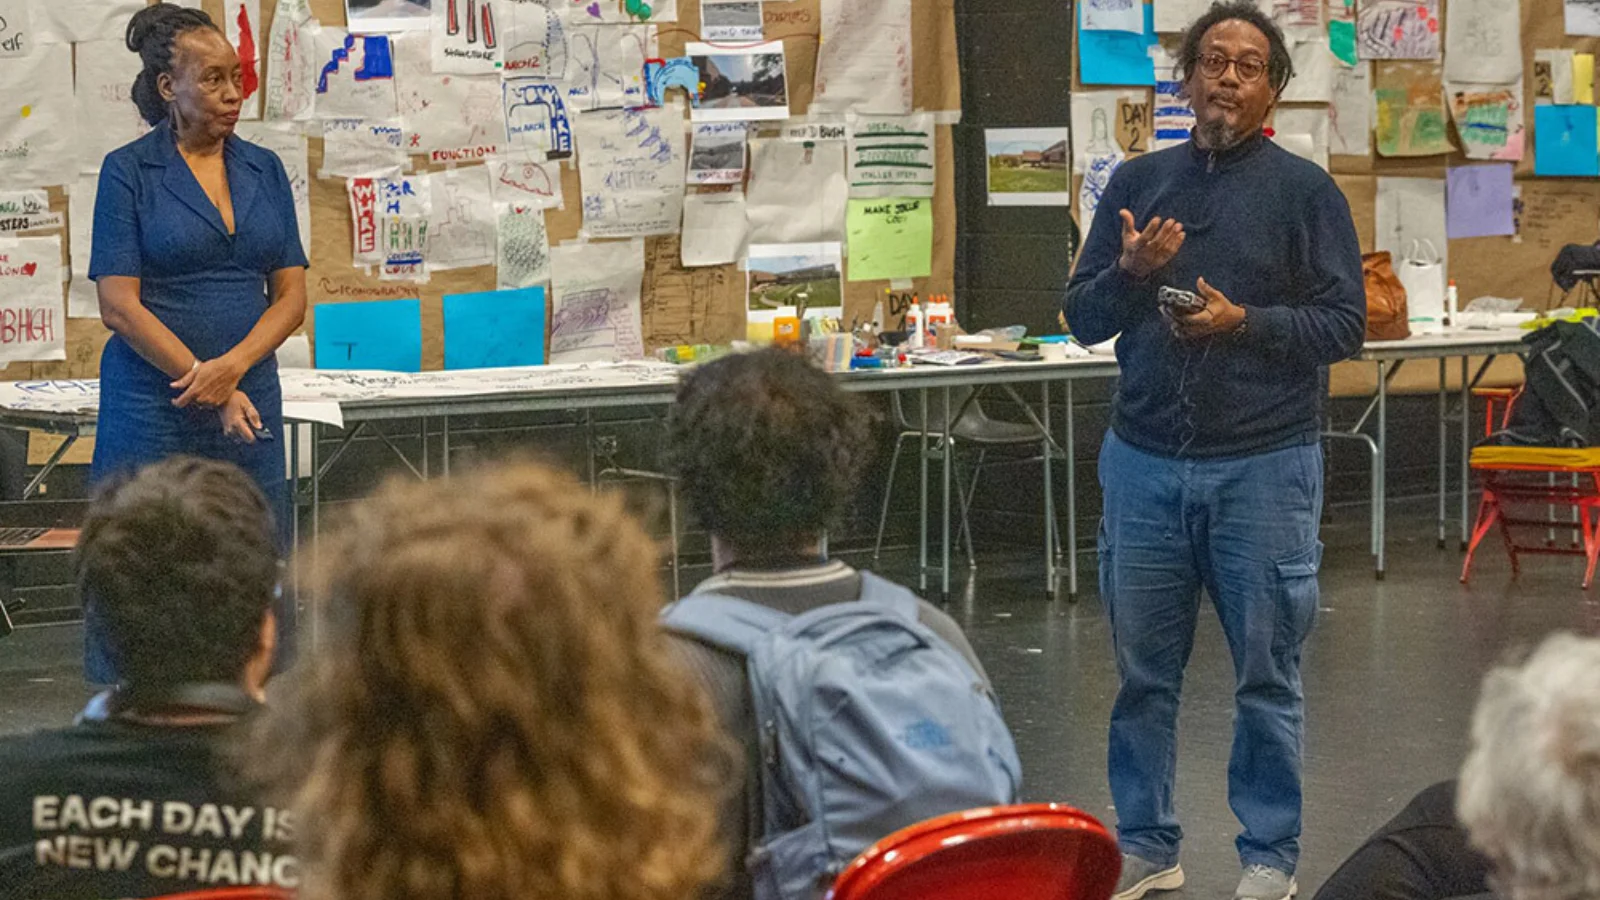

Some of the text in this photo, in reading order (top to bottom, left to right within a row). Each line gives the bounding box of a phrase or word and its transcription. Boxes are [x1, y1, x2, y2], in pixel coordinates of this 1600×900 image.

[1122, 104, 1149, 128] DAY
[1128, 127, 1145, 152] 2
[33, 794, 153, 831] EACH
[162, 800, 255, 838] DAY
[34, 835, 139, 870] NEW
